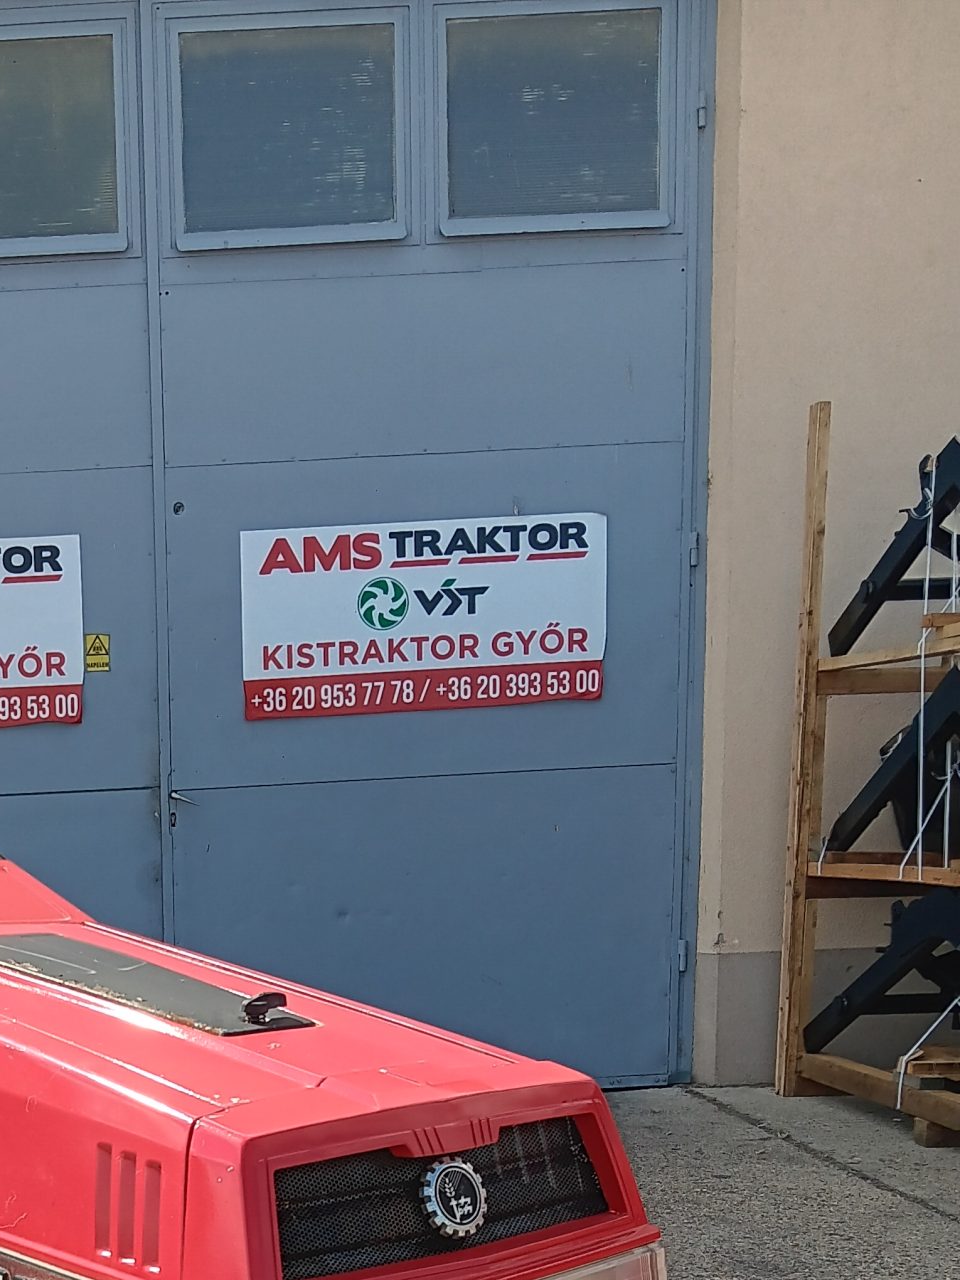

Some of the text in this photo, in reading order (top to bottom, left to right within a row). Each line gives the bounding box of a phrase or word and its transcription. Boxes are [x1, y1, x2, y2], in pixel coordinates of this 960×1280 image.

[259, 522, 589, 575] AMS TRAKTOR
[263, 623, 588, 670] KISTRAKTOR GYŐR
[27, 695, 49, 719] 53
[56, 694, 78, 717] 00
[252, 688, 286, 711] +36
[292, 686, 315, 710] 20
[321, 684, 355, 708] 953
[362, 682, 384, 705] 77
[391, 680, 413, 703] 78
[436, 676, 471, 700] +36
[477, 675, 500, 698] 20
[506, 672, 540, 697] 393
[547, 671, 569, 694] 53
[576, 670, 598, 693] 00
